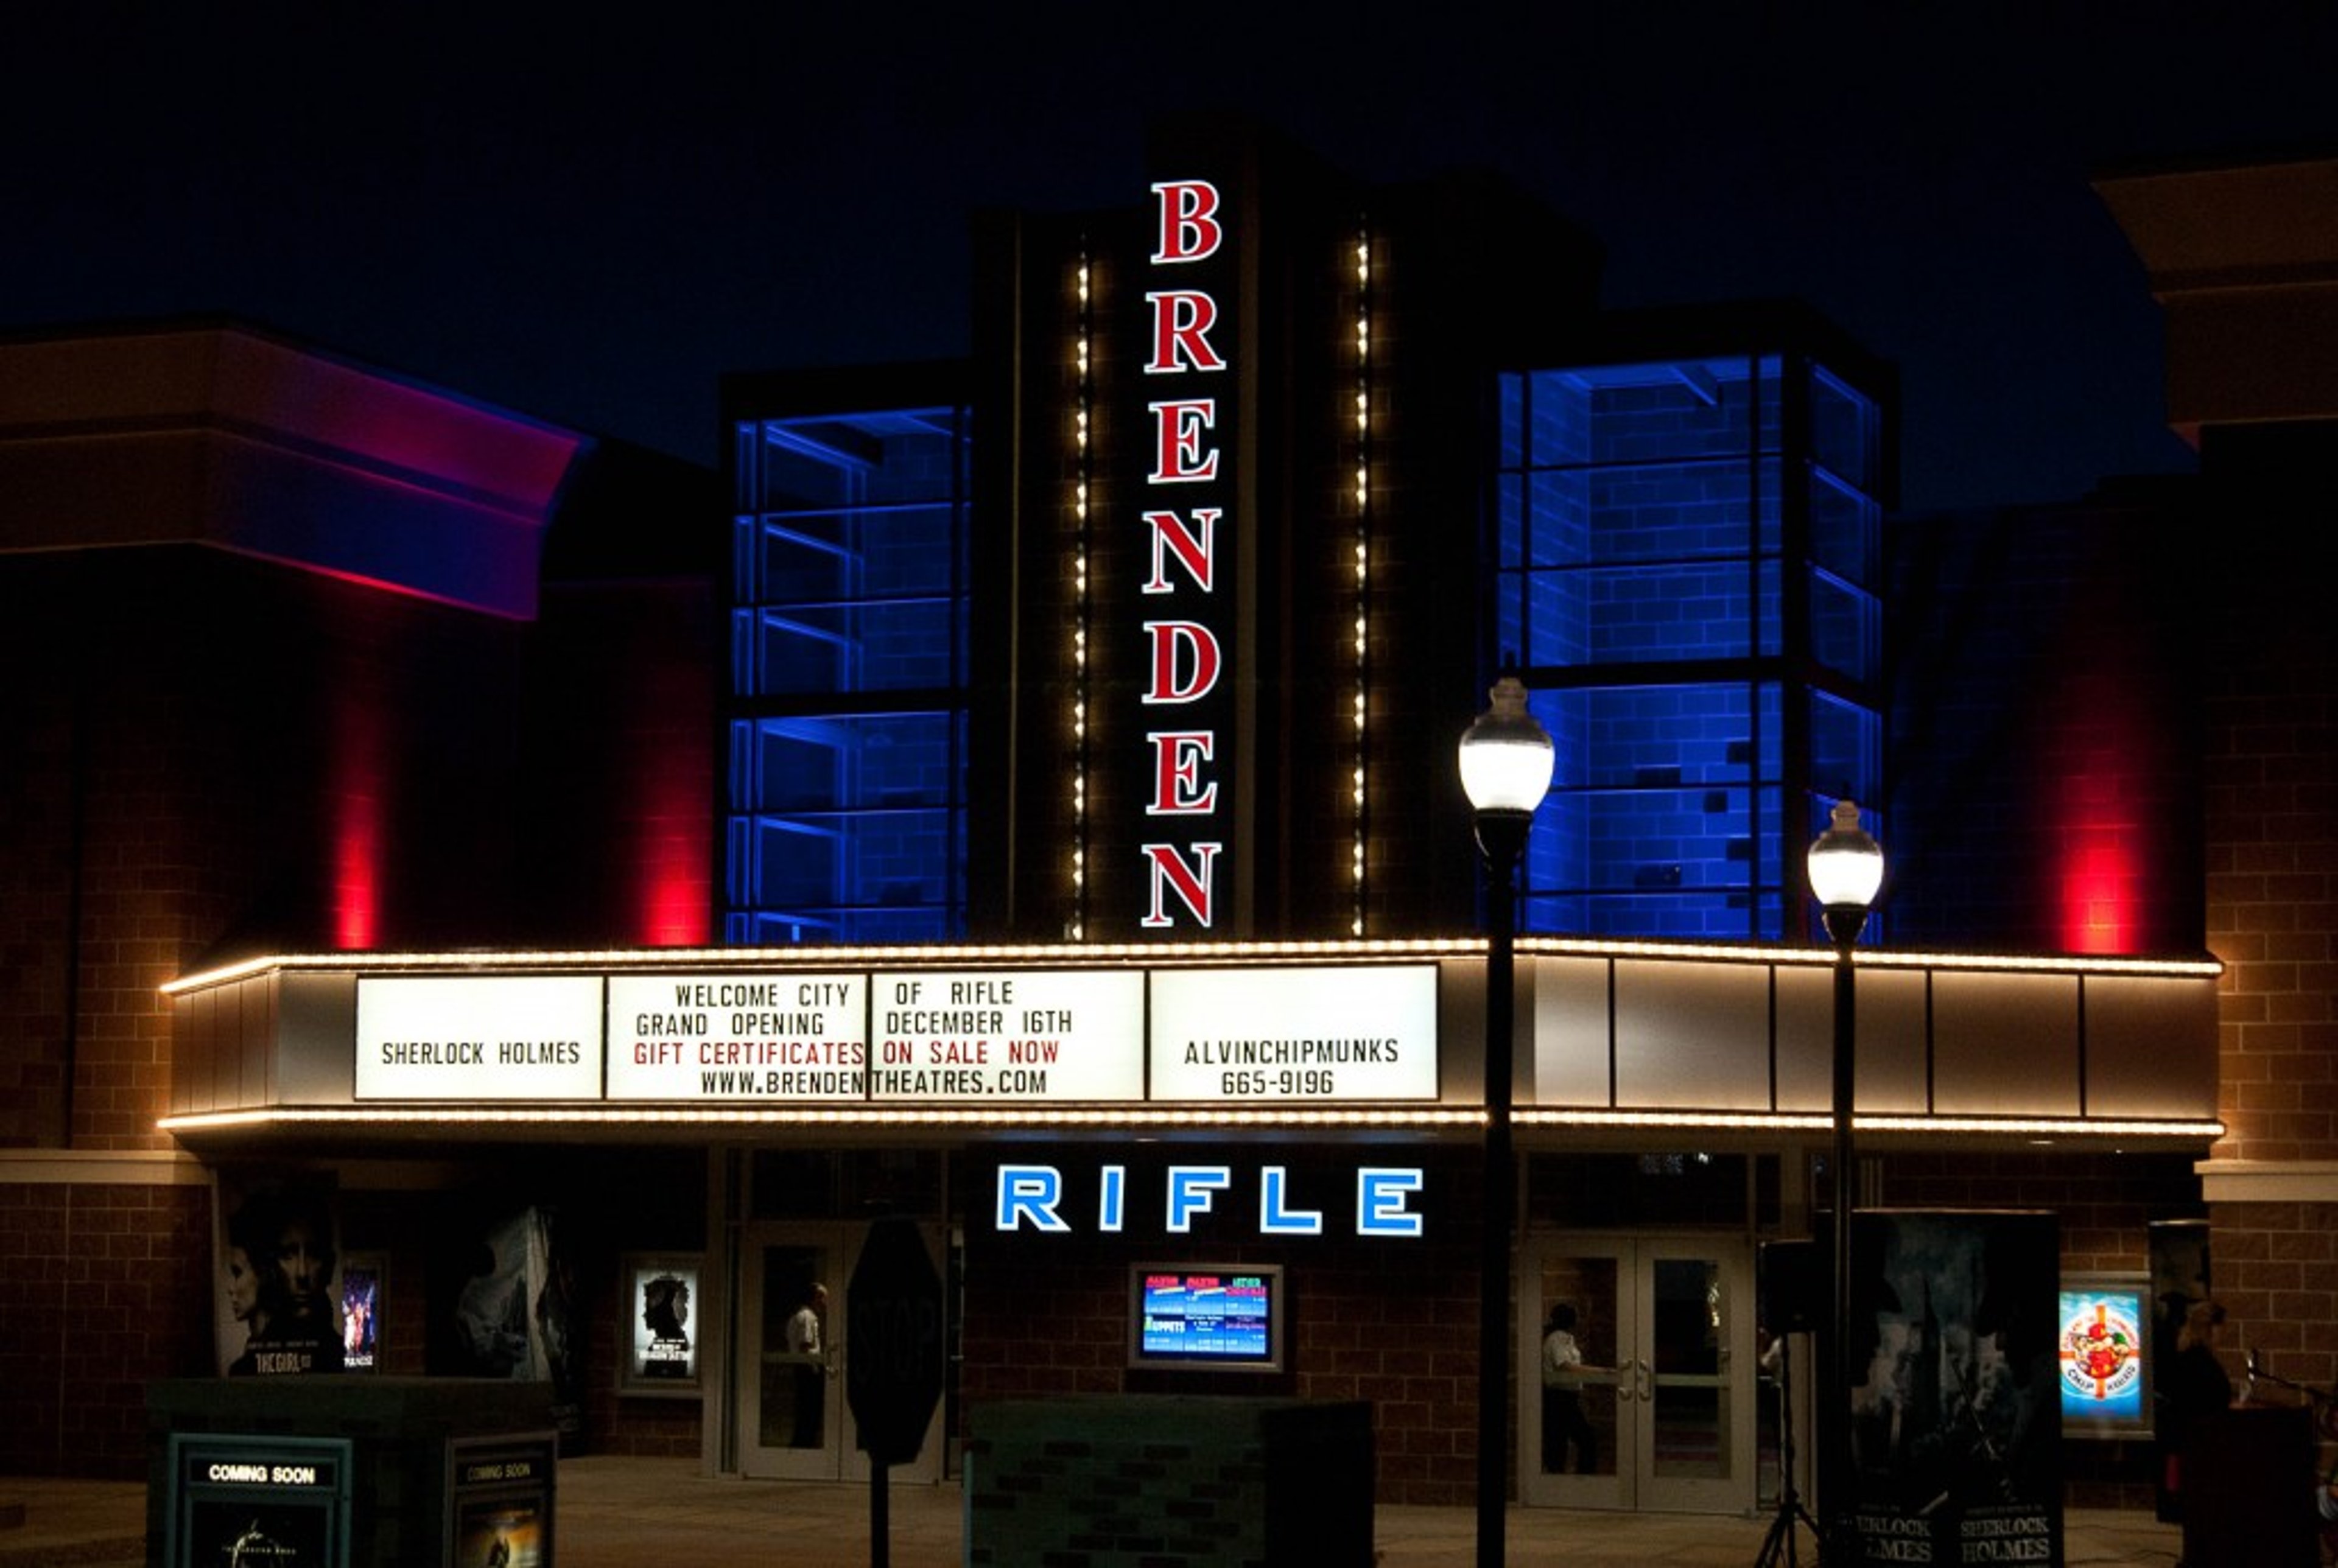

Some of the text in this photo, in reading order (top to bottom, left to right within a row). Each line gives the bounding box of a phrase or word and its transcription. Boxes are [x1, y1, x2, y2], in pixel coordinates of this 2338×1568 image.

[1142, 180, 1226, 927] BRENDEN
[676, 981, 1011, 1007] WELCOME CITY OF RIFLE
[637, 1013, 823, 1035] GRAND OPENING
[887, 1011, 1071, 1034] DECEMBER 16TH
[383, 1043, 579, 1064] SHERLOCK HOLMES
[635, 1041, 1058, 1064] GIFT CERTIFICATES ON SALE NOW
[1185, 1039, 1397, 1064] ALVINCHIPMUNKS
[1223, 1071, 1332, 1094] 665-9196
[997, 1166, 1422, 1236] RIFLE
[854, 1295, 936, 1387] STOP
[209, 1465, 315, 1483] COMING SOON
[467, 1461, 531, 1482] COMING SOON
[1960, 1516, 2050, 1536] SHERLOCK
[1961, 1538, 2052, 1563] HOLMES
